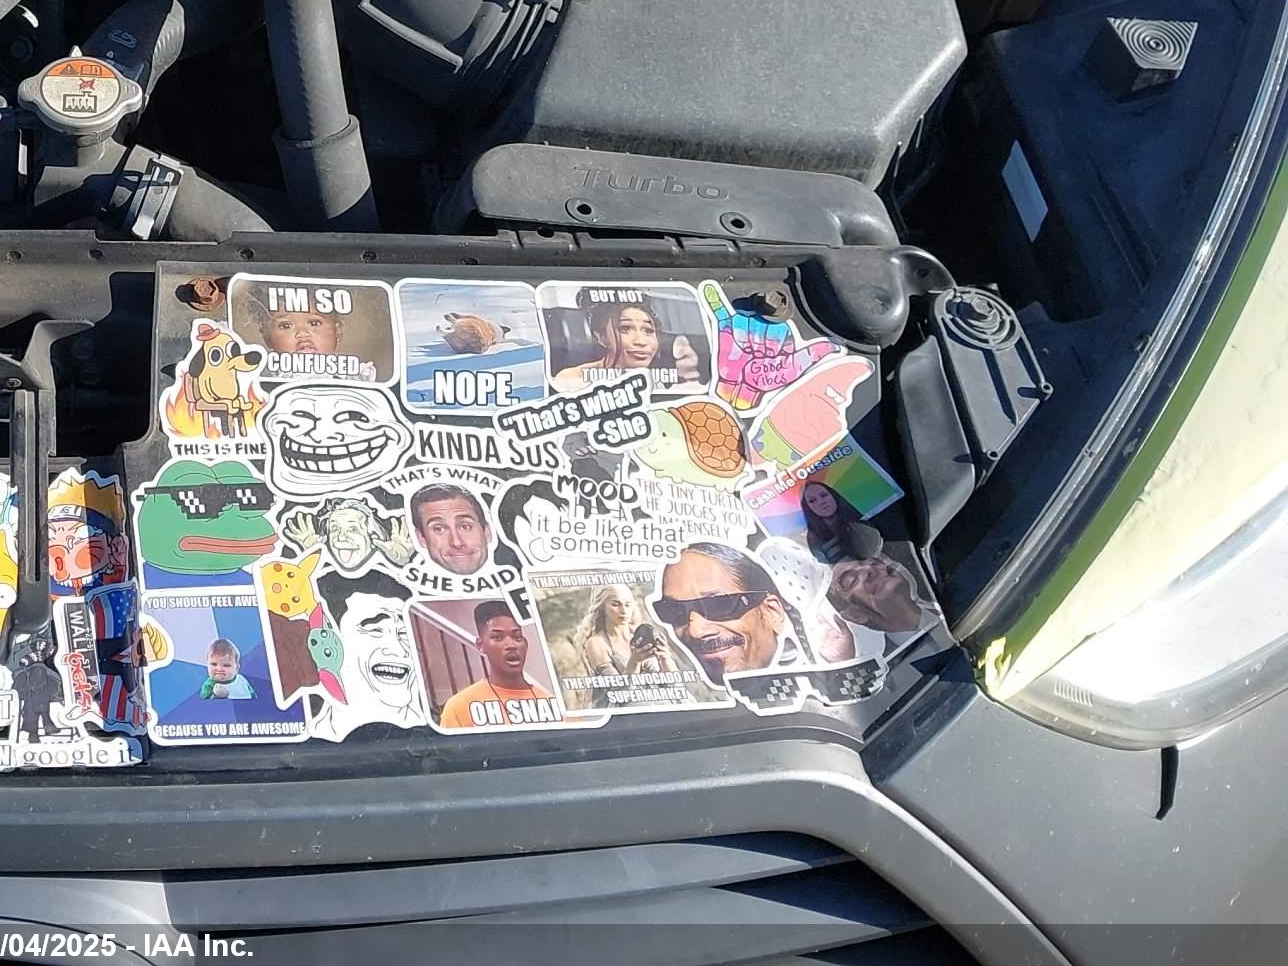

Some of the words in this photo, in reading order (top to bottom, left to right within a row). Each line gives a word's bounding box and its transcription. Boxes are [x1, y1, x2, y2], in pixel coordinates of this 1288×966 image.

[572, 165, 729, 200] Turbo
[268, 287, 310, 313] I'M
[314, 289, 353, 314] SO
[589, 289, 616, 303] BUT
[617, 290, 644, 303] NOT
[266, 351, 360, 376] CONFUSED
[750, 361, 786, 375] Good
[598, 415, 648, 444] -She
[173, 443, 212, 455] THIS
[215, 443, 231, 455] IS
[235, 442, 268, 455] FINE
[418, 429, 502, 464] KINDA
[508, 438, 560, 469] SUS
[385, 467, 443, 490] THAT'S
[447, 468, 502, 491] WHAT
[557, 475, 638, 504] MOOD
[637, 477, 662, 496] THIS
[670, 485, 695, 502] TINY
[747, 488, 777, 509] Cash
[775, 478, 796, 496] Me
[796, 445, 854, 480] Ousside
[646, 497, 661, 511] HE
[668, 500, 717, 522] JUDGES
[722, 512, 749, 529] YOU
[537, 514, 550, 532] it
[558, 516, 586, 535] be
[595, 518, 634, 540] like
[642, 522, 686, 543] that
[550, 535, 678, 559] sometimes
[405, 567, 454, 592] SHE
[462, 569, 516, 593] SAID
[533, 575, 560, 589] THAT
[559, 573, 605, 587] MOMENT
[605, 571, 636, 585] WHEN
[147, 596, 168, 609] YOU
[168, 596, 211, 609] SHOULD
[212, 596, 234, 608] FEEL
[562, 677, 584, 690] THE
[584, 675, 630, 690] PERFECT
[630, 672, 681, 686] AVOCADO
[682, 671, 697, 684] AT
[606, 687, 689, 704] SUPERMARKET
[469, 700, 504, 726] OH
[155, 725, 204, 738] BECAUSE
[204, 724, 228, 737] YOU
[229, 723, 250, 736] ARE
[251, 722, 306, 736] AWESOME
[23, 743, 109, 766] google
[120, 742, 136, 763] it
